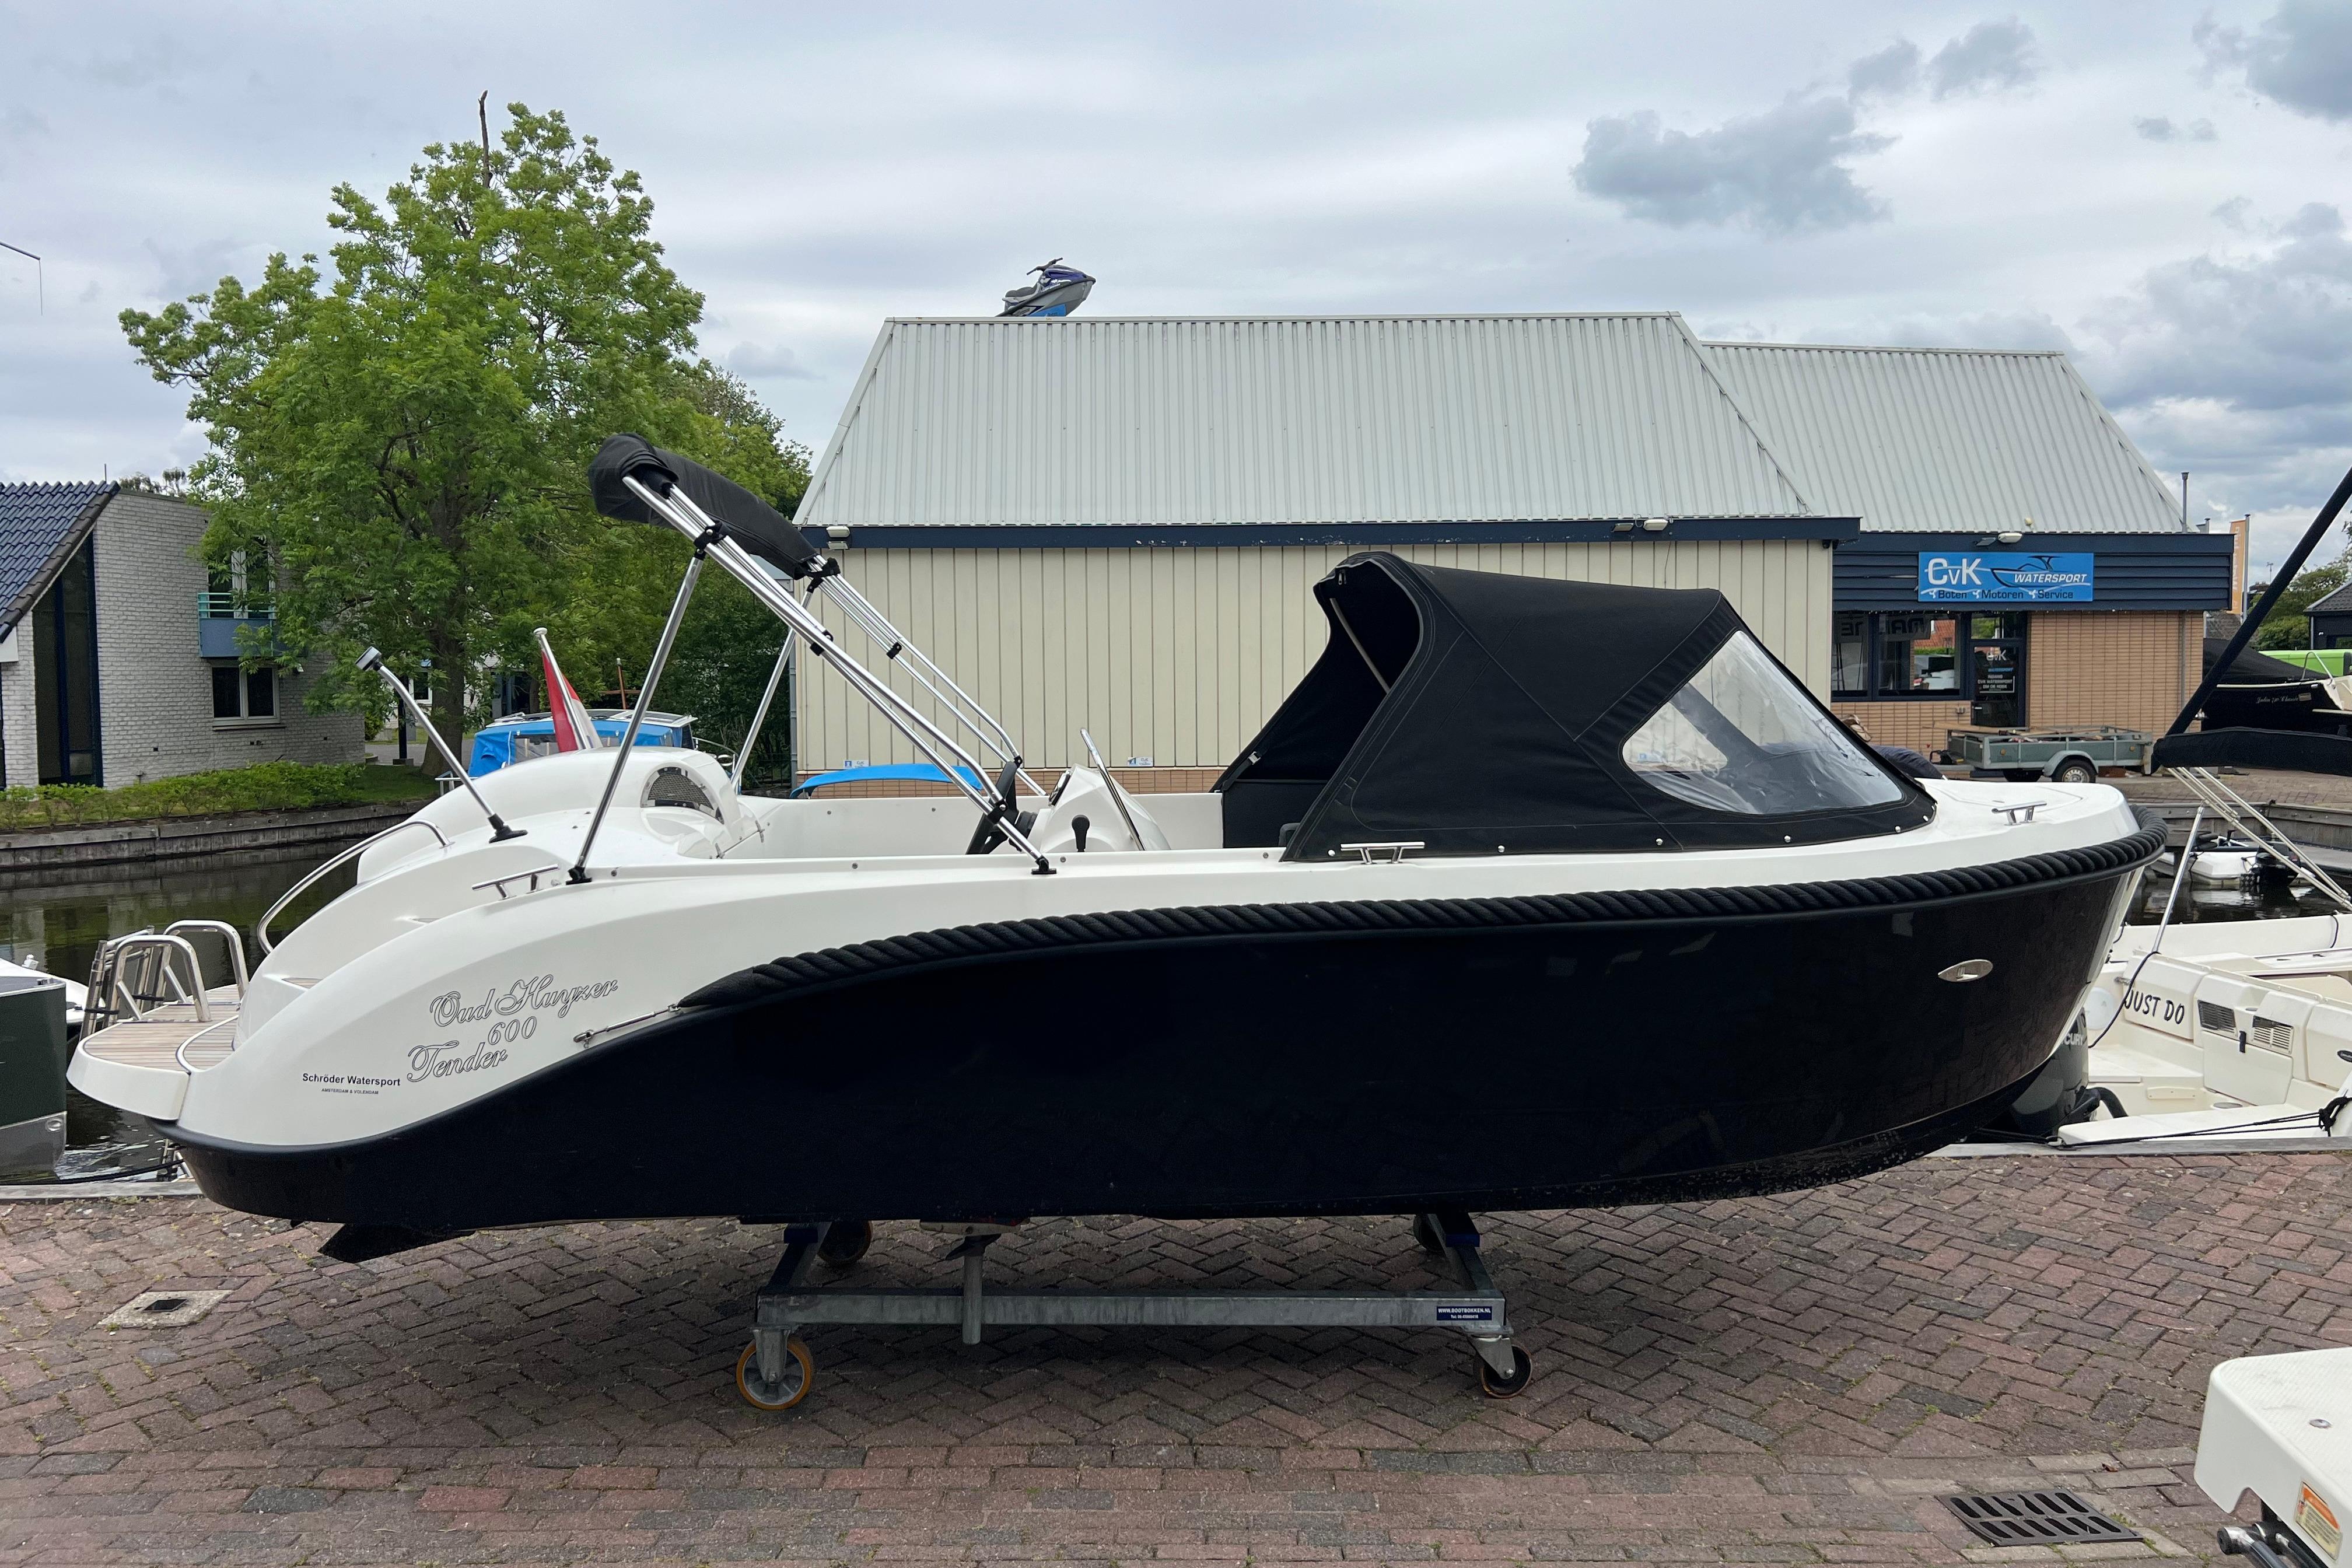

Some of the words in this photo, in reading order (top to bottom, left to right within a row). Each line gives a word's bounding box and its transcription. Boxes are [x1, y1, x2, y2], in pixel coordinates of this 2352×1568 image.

[1927, 558, 1982, 585] CvK
[2014, 573, 2087, 583] WATERSPORT
[1938, 590, 1967, 598] Boten
[1982, 590, 2024, 598] Motoren
[2038, 590, 2073, 598] Service
[429, 989, 496, 1027] Oud
[2124, 989, 2161, 1017] JUST
[2164, 1000, 2185, 1024] DO
[488, 1016, 537, 1045] 600
[2062, 1032, 2084, 1046] CURY
[407, 1040, 509, 1083] Tender
[303, 1073, 345, 1084] Schröder
[347, 1076, 401, 1087] Watersport
